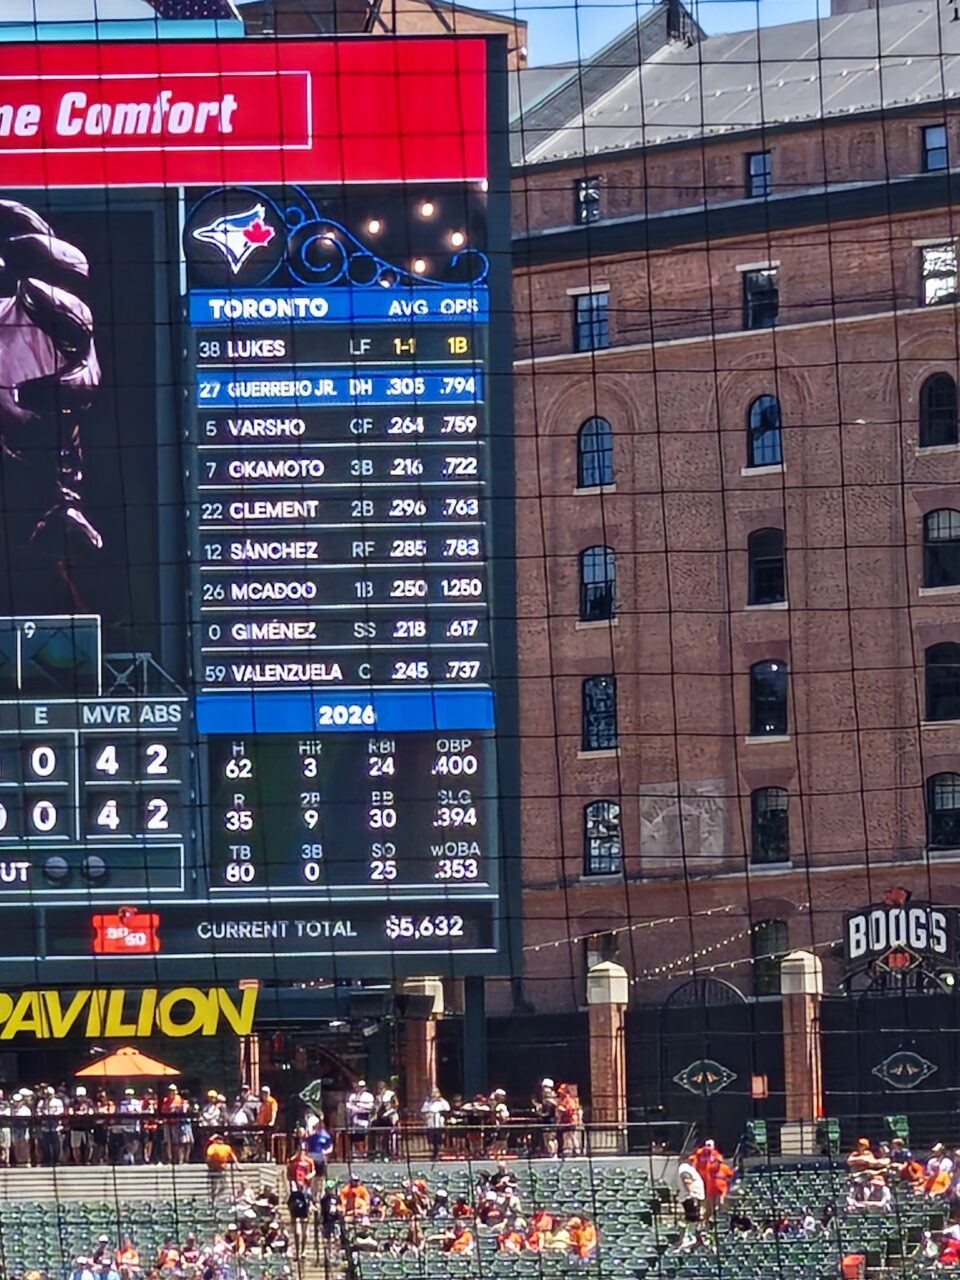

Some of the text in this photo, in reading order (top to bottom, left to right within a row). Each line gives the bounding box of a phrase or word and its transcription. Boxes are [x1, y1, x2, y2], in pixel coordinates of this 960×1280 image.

[57, 91, 237, 135] Comfort
[209, 298, 478, 319] TORONTO AVG OPS
[199, 337, 468, 358] 38 LUKES 1-1 1B
[199, 382, 220, 398] 27
[227, 379, 311, 398] GUERRERO
[350, 379, 372, 395] DH
[386, 378, 424, 394] .305
[440, 377, 475, 394] .794
[227, 416, 477, 437] VARSHO .759
[229, 460, 324, 478] OKAMOTO
[443, 457, 477, 475] .722
[202, 503, 222, 519] 22
[229, 501, 319, 519] CLEMENT
[204, 544, 222, 560] 12
[352, 542, 375, 557] RF
[203, 584, 225, 600] 26
[231, 582, 317, 600] MCADOO
[393, 620, 427, 638] .218
[446, 620, 478, 637] .617
[205, 660, 480, 682] 59 VALENZUELA .245 .737
[84, 704, 181, 725] MVR ABS
[318, 705, 375, 725] 2026
[437, 738, 472, 753] OBP
[32, 746, 56, 776] 0
[96, 745, 119, 775] 4
[146, 744, 168, 774] 2
[225, 755, 478, 779] 62 24 .400
[98, 799, 119, 830] 4
[147, 799, 169, 829] 2
[225, 807, 477, 831] 35 30 .394
[229, 845, 251, 861] TB
[301, 844, 323, 859] 3B
[370, 859, 478, 880] 25 .353
[197, 914, 464, 940] CURRENT TOTAL $5,632
